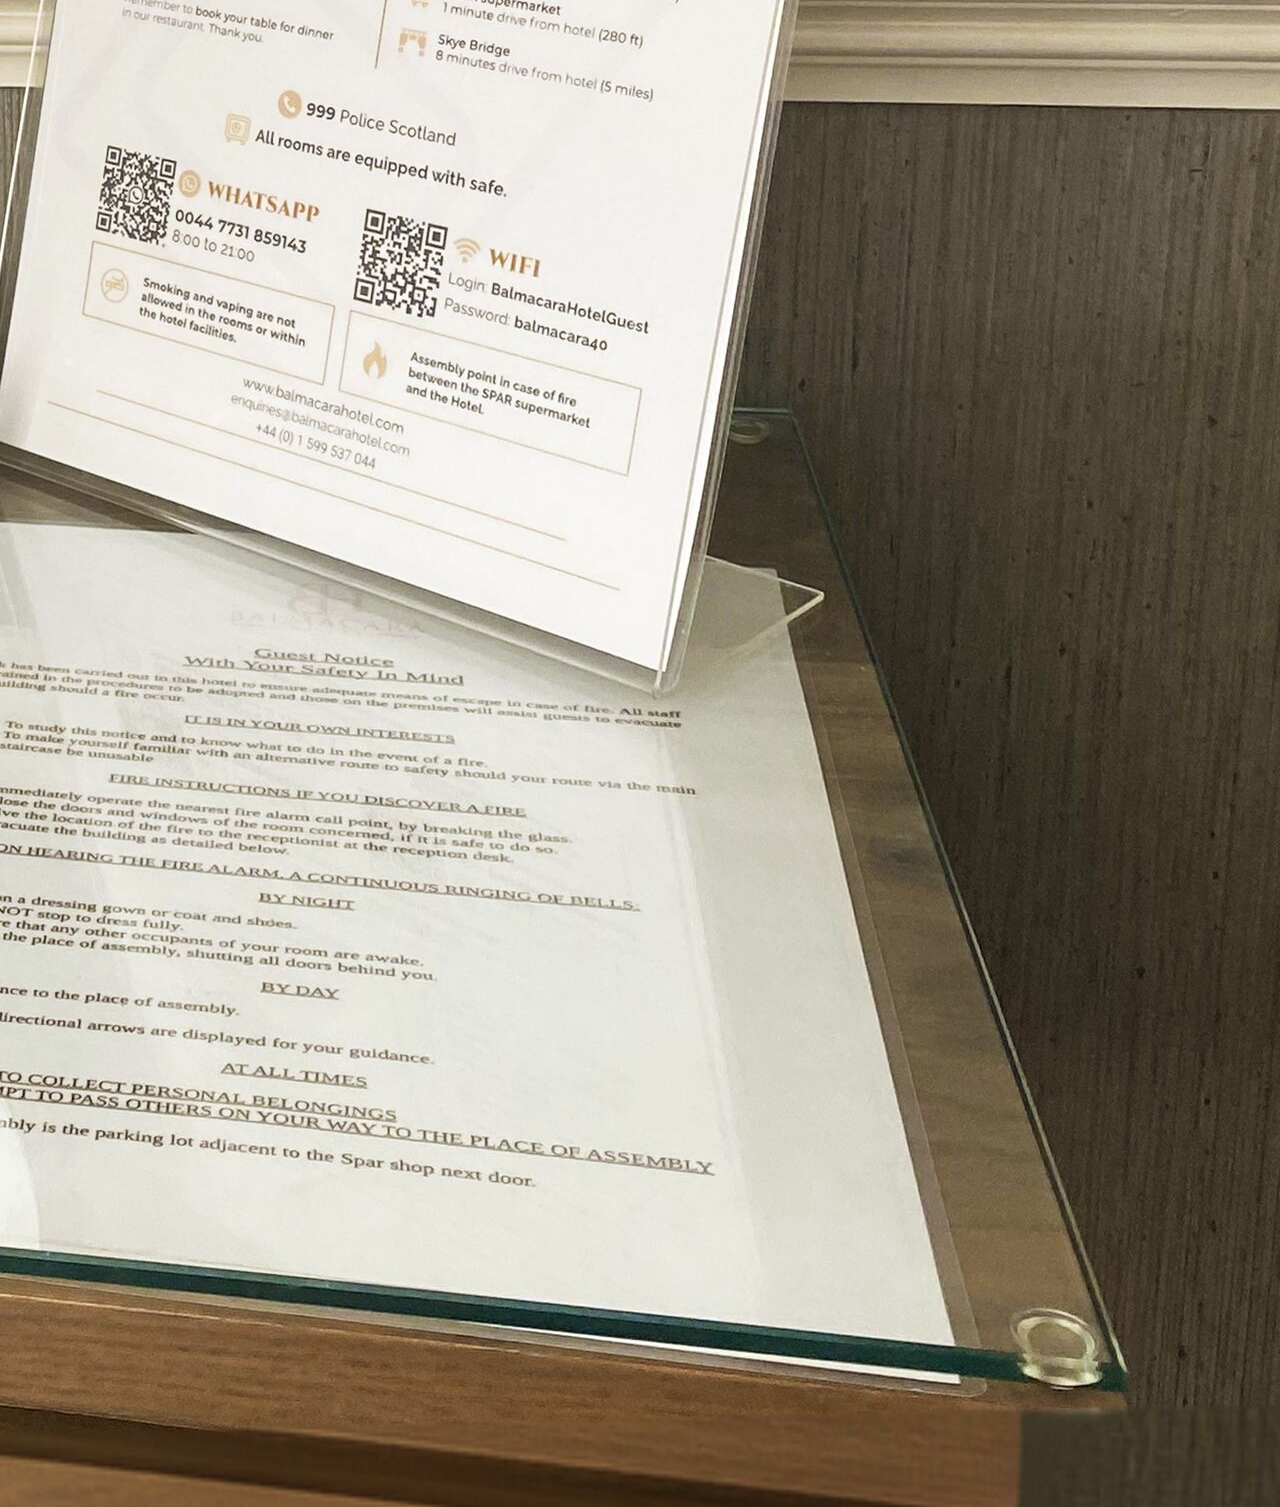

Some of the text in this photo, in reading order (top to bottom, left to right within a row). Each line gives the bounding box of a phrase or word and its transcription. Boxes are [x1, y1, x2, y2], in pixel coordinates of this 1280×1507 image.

[437, 33, 511, 59] Skye Bridge
[305, 102, 458, 147] 999 Police Scotland
[254, 128, 508, 198] All rooms are equipped with safe.
[207, 180, 321, 223] WHATSAPP
[170, 227, 256, 263] 8:00 to 21:00
[174, 208, 308, 254] 0044 7731 859143
[489, 248, 541, 279] WIFI
[490, 281, 649, 335] BalmacaraHotelGuest
[513, 314, 609, 352] balmacara40
[229, 393, 411, 458] enquiries@balmacarahotel.com
[242, 377, 405, 435] www.balmacarahotel.com
[255, 423, 278, 439] +44
[277, 427, 295, 447] (0)
[305, 436, 329, 455] 599
[329, 443, 353, 462] 537
[353, 451, 377, 470] 044
[182, 655, 465, 685] With Your Safety In Mind
[253, 647, 395, 668] Guest Notice
[250, 719, 305, 732] YOUR
[302, 723, 351, 735] OWN
[355, 726, 456, 743] INTERESTS
[258, 891, 356, 910] BY NIGHT
[260, 981, 340, 999] BY DAY
[220, 1062, 368, 1087] AT ALL TIMES
[26, 1073, 123, 1093] COLLECT
[130, 1082, 246, 1105] PERSONAL
[250, 1094, 398, 1122] BELONGINGS
[40, 1120, 57, 1134] is
[61, 1122, 91, 1137] the
[94, 1128, 165, 1148] parking
[169, 1133, 195, 1148] lot
[198, 1137, 278, 1157] adjacent
[282, 1147, 301, 1160] to
[306, 1148, 335, 1164] the
[340, 1152, 386, 1170] Spar
[389, 1158, 436, 1178] shop
[440, 1166, 483, 1182] next
[487, 1170, 538, 1188] door.
